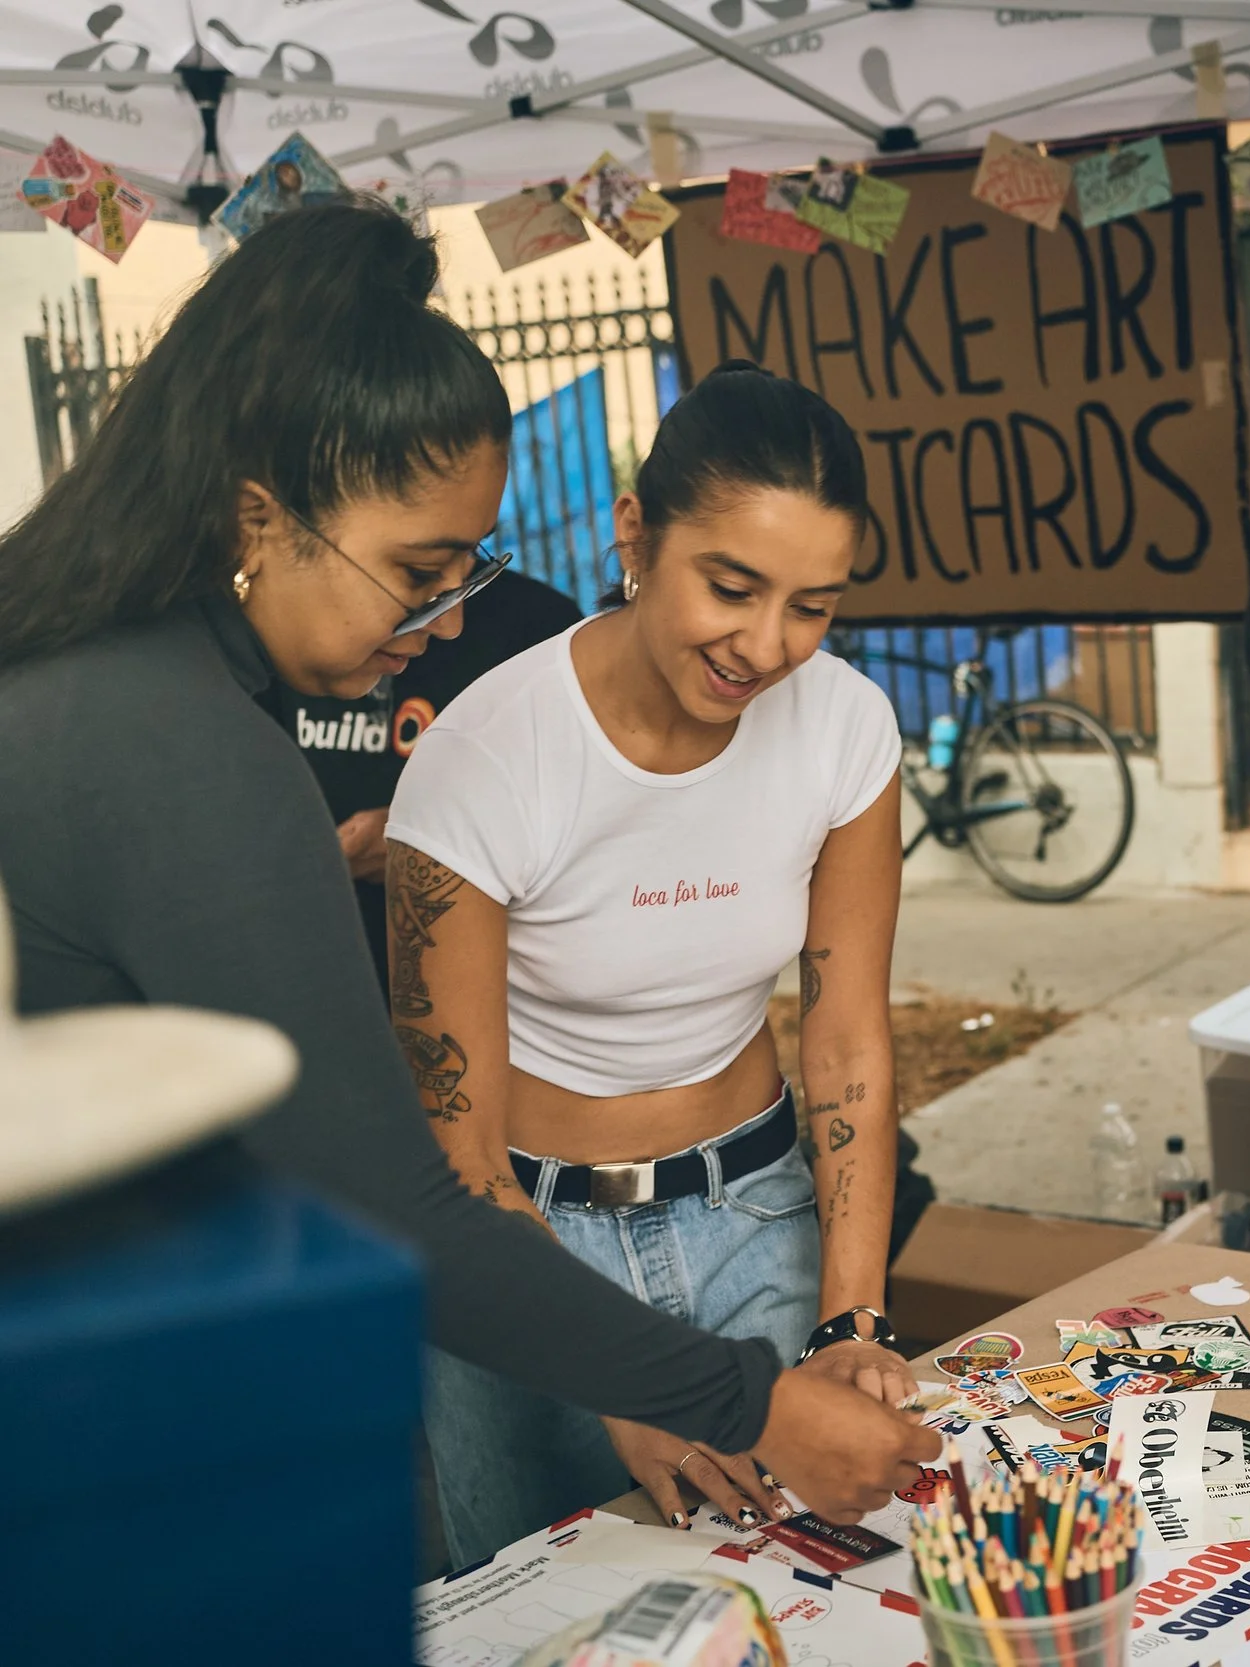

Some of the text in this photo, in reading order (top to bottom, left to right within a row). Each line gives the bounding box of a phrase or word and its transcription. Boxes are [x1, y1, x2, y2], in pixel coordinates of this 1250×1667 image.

[709, 192, 1205, 401] MAKE ART
[850, 400, 1212, 584] STCARDS
[297, 708, 388, 755] build
[632, 877, 741, 909] loca for love
[1023, 1366, 1071, 1385] Vespa
[1138, 1427, 1191, 1544] Oberheim
[518, 1555, 551, 1572] Mark
[436, 1571, 522, 1613] Mothersbaugh
